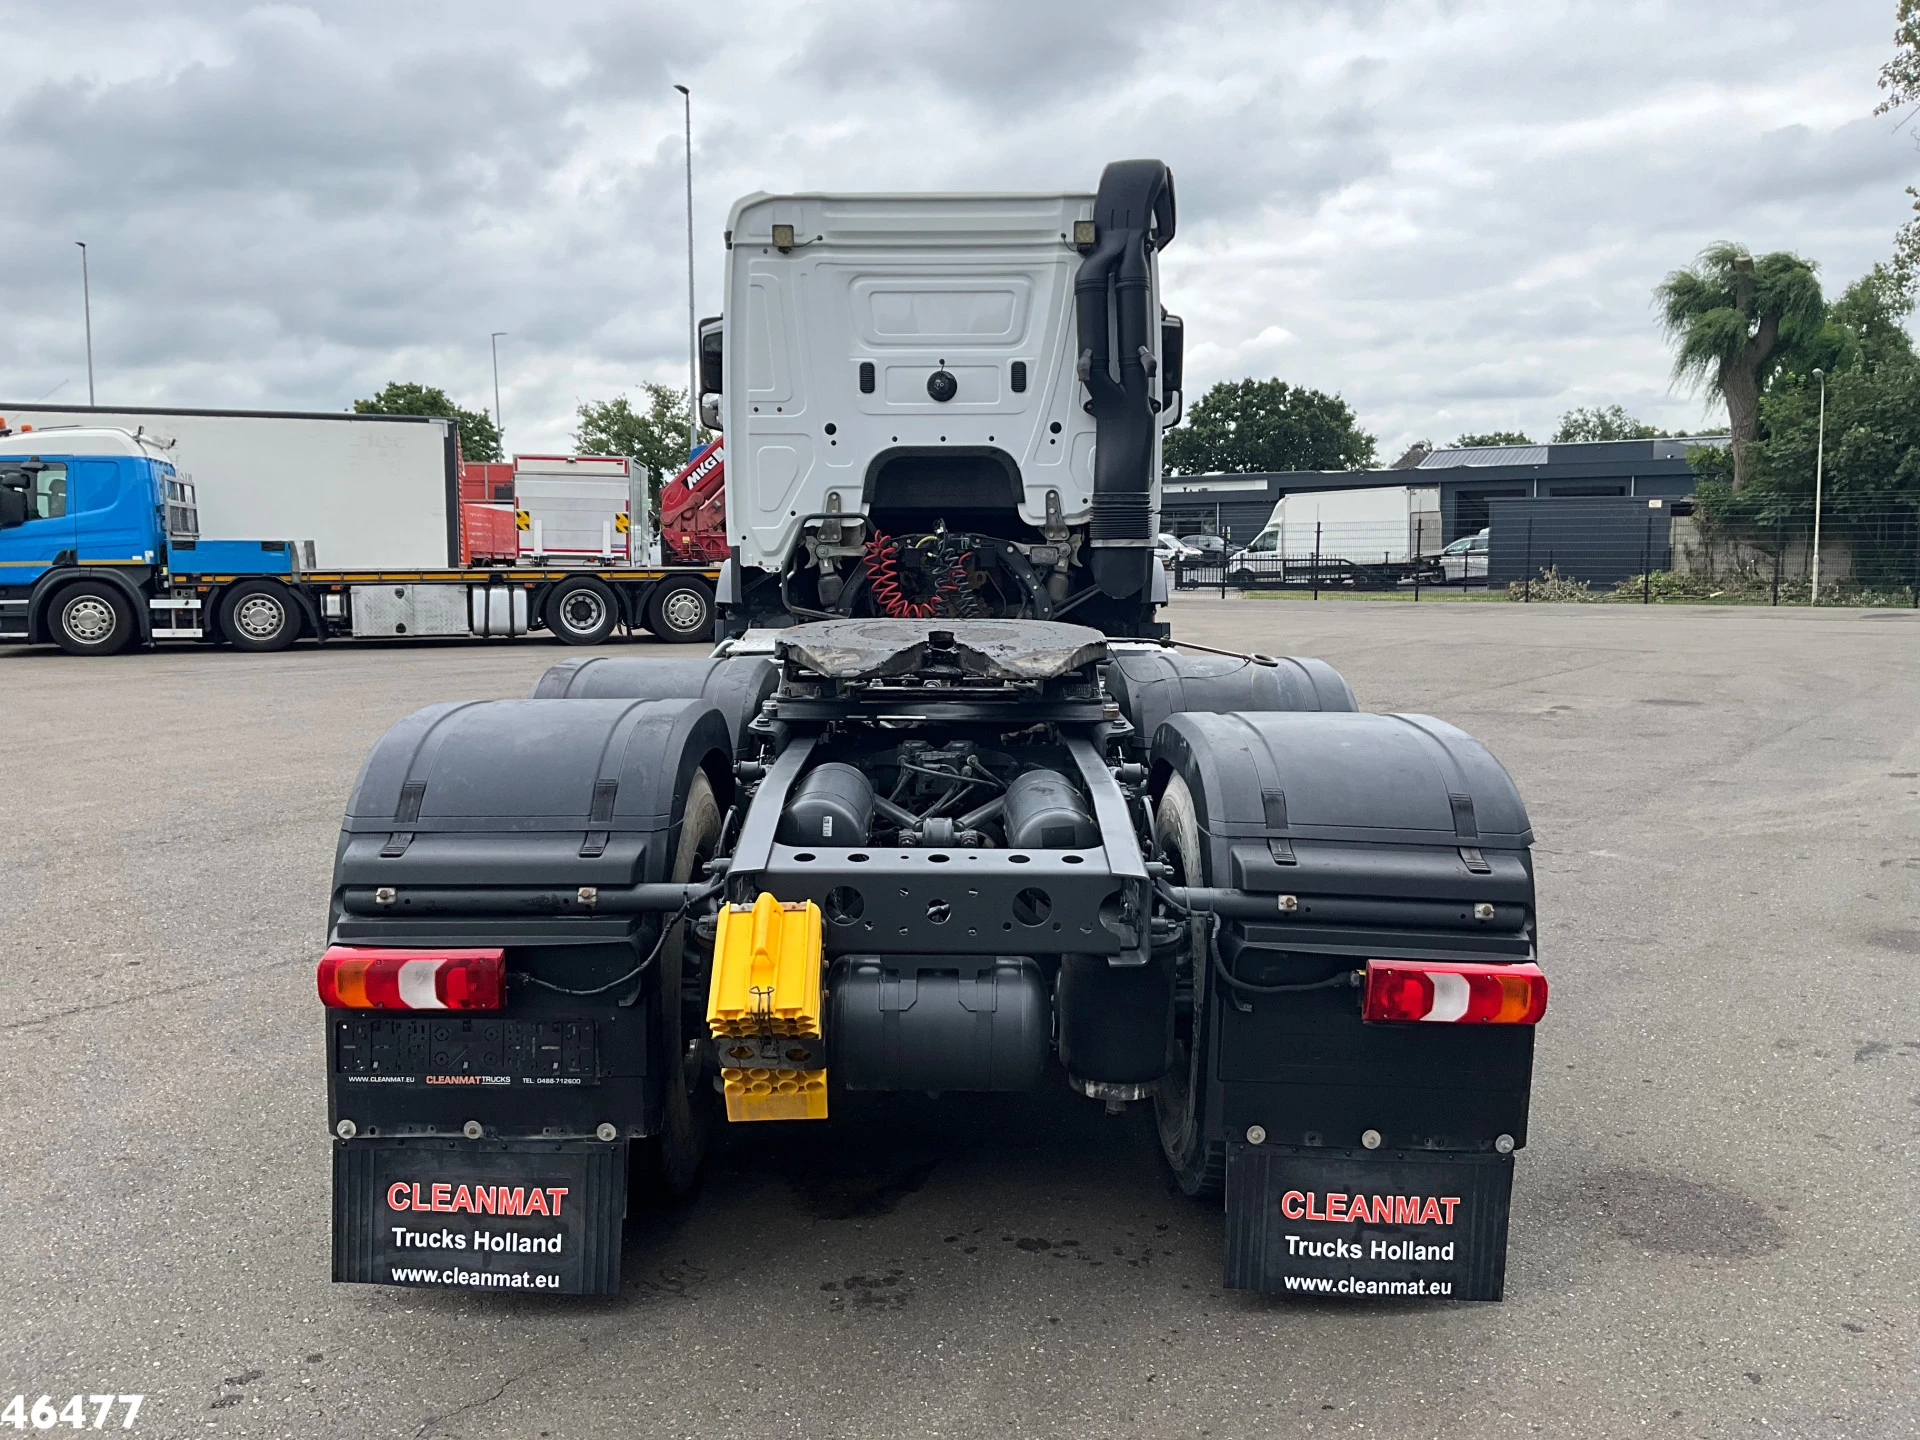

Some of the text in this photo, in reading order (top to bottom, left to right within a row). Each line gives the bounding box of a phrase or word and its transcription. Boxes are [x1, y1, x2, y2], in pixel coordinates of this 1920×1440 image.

[686, 456, 718, 490] MKG
[387, 1182, 569, 1216] CLEANMAT
[1281, 1190, 1460, 1225] CLEANMAT
[391, 1227, 562, 1253] Trucks Holland
[1284, 1235, 1455, 1261] Trucks Holland
[391, 1266, 560, 1288] www.cleanmat.eu
[1283, 1275, 1452, 1295] www.cleanmat.eu
